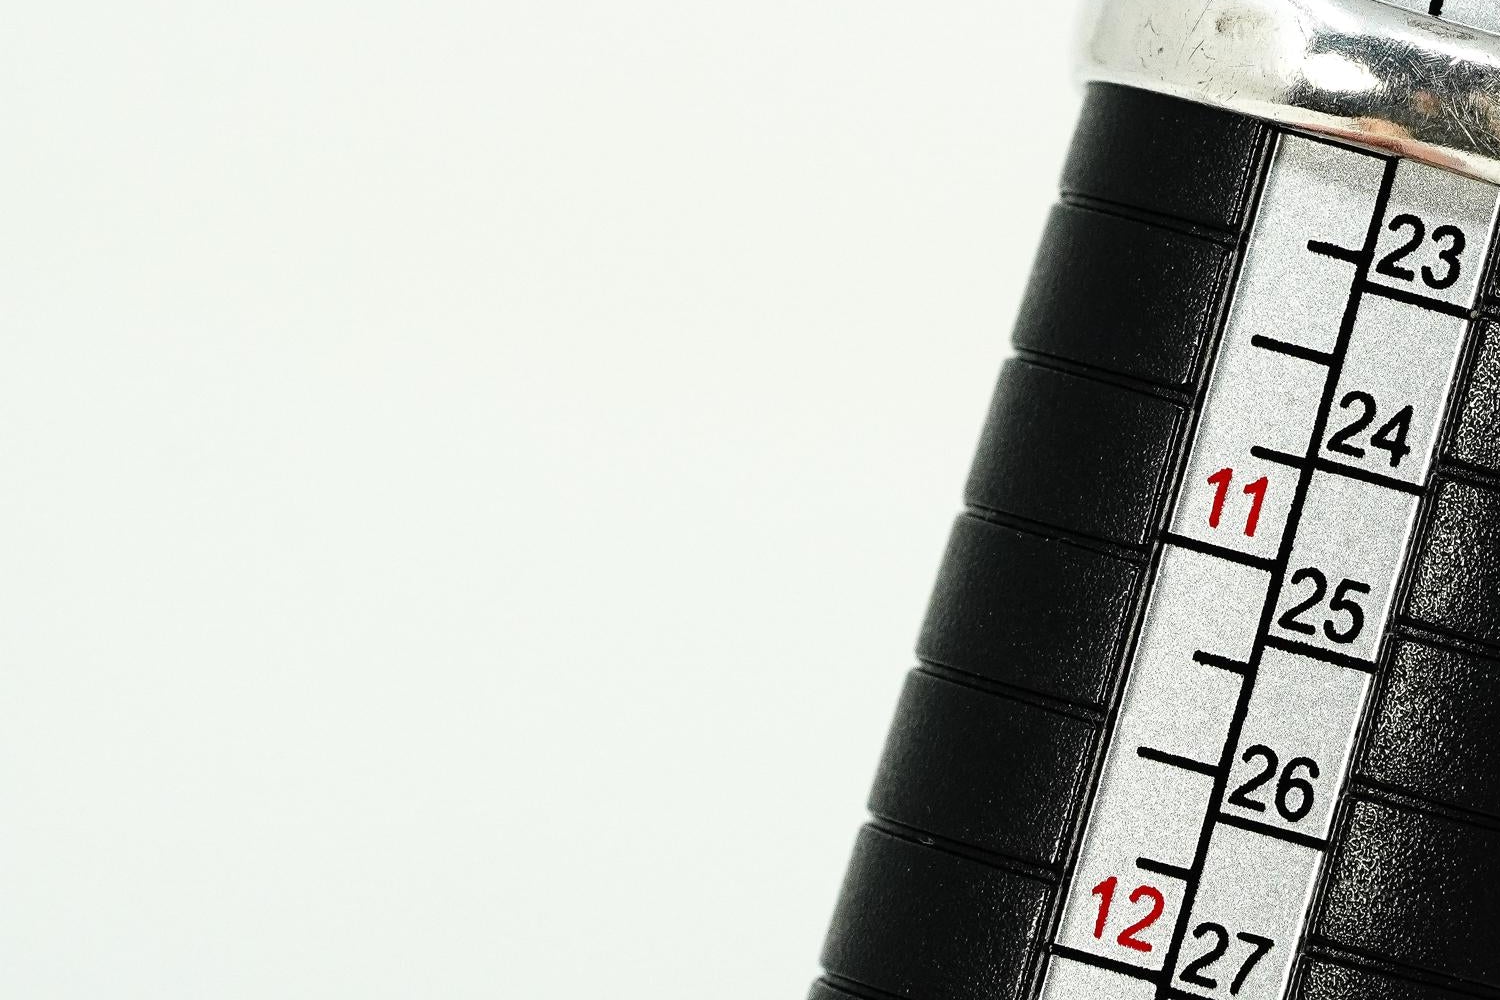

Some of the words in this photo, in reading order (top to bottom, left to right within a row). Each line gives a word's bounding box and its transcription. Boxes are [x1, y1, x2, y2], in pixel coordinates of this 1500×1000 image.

[1374, 212, 1467, 291] 23
[1325, 389, 1416, 470] 24
[1206, 466, 1270, 538] 11
[1276, 565, 1373, 646] 25
[1226, 742, 1321, 824] 26
[1090, 874, 1167, 954] 12
[1177, 920, 1276, 998] 27
